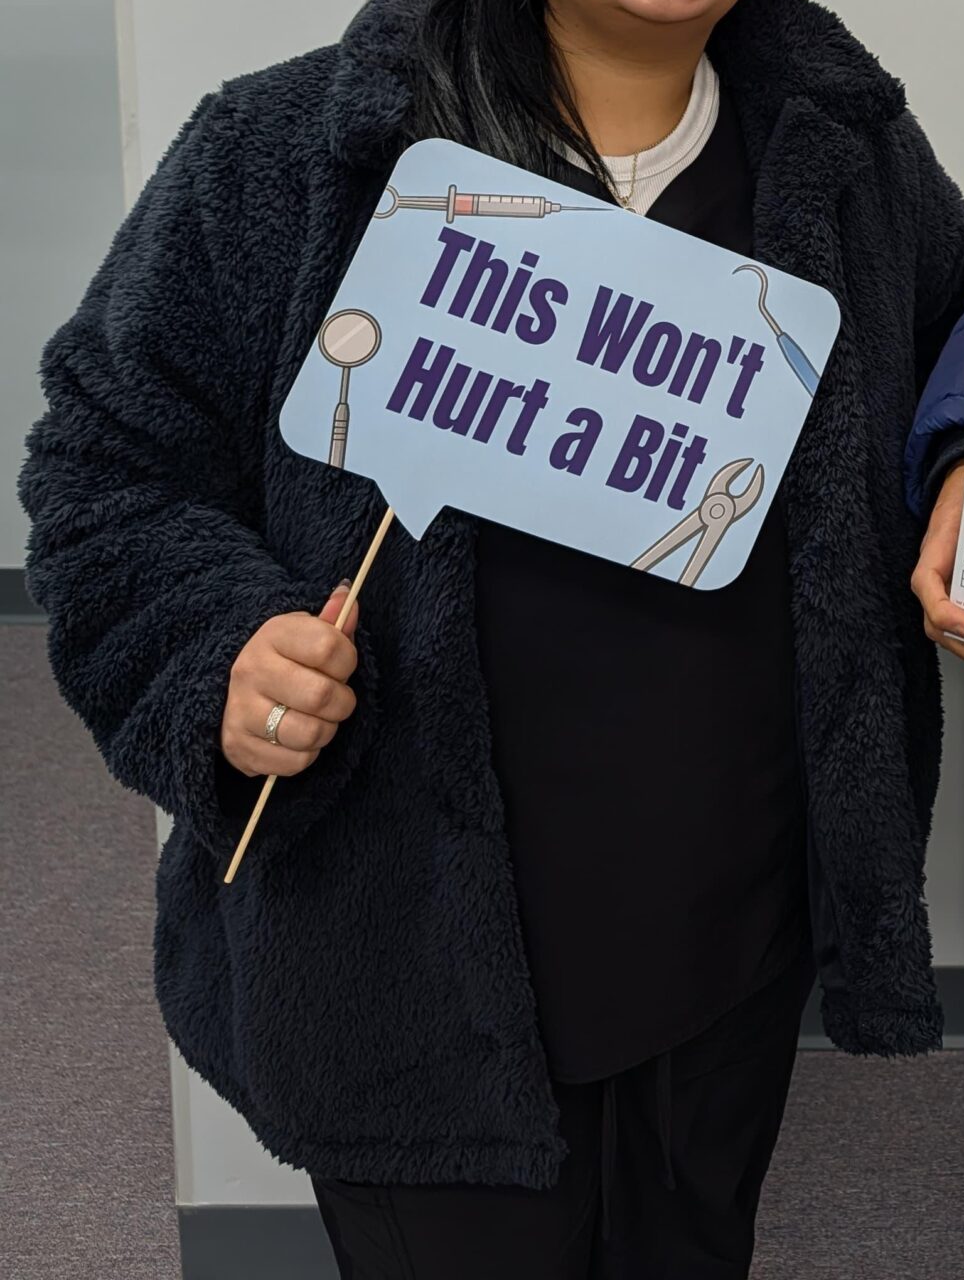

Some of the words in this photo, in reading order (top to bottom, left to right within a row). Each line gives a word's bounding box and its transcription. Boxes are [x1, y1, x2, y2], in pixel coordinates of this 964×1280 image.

[419, 227, 568, 345] This
[576, 285, 766, 419] Won't
[386, 337, 550, 457] Hurt
[549, 407, 604, 475] a
[606, 414, 709, 511] Bit
